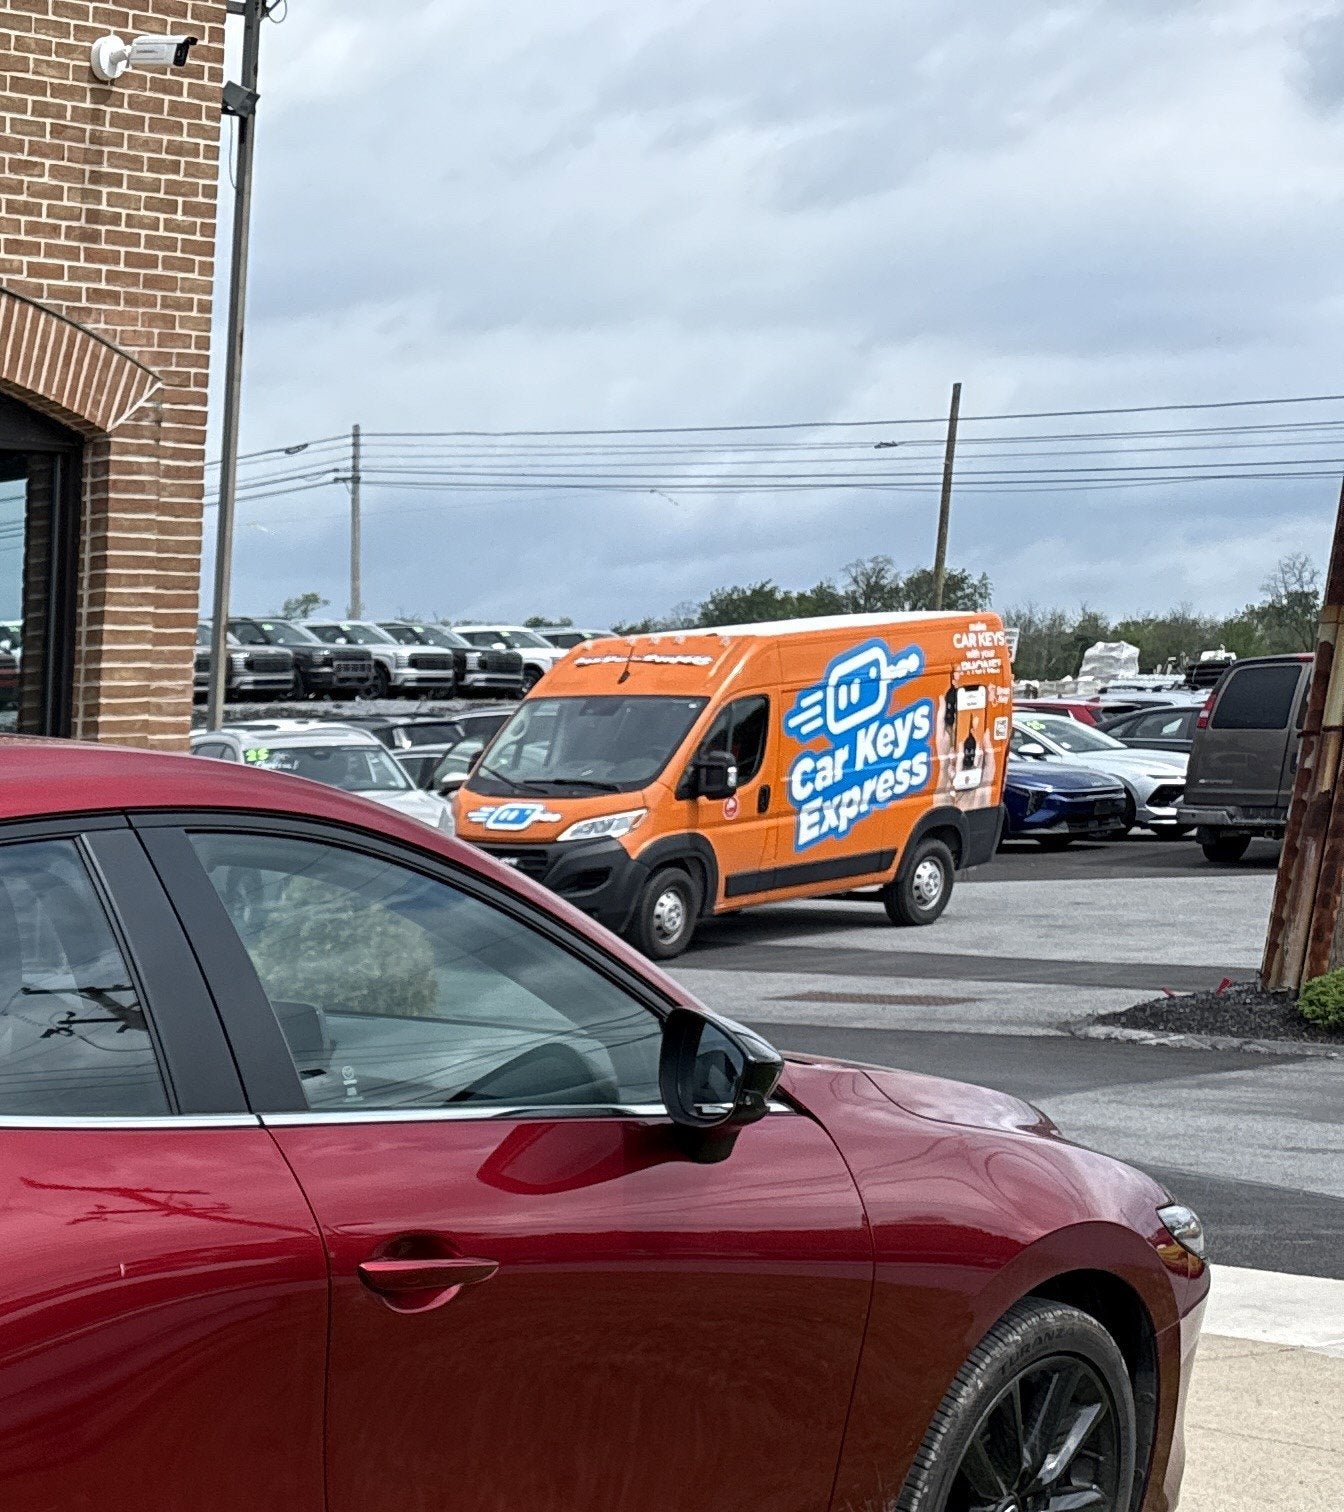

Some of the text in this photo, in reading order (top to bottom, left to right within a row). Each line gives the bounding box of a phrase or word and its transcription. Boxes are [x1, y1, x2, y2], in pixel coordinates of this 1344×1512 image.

[953, 632, 977, 649] CAR
[978, 631, 1005, 648] KEYS
[791, 704, 930, 801] Car Keys
[797, 751, 929, 846] Express
